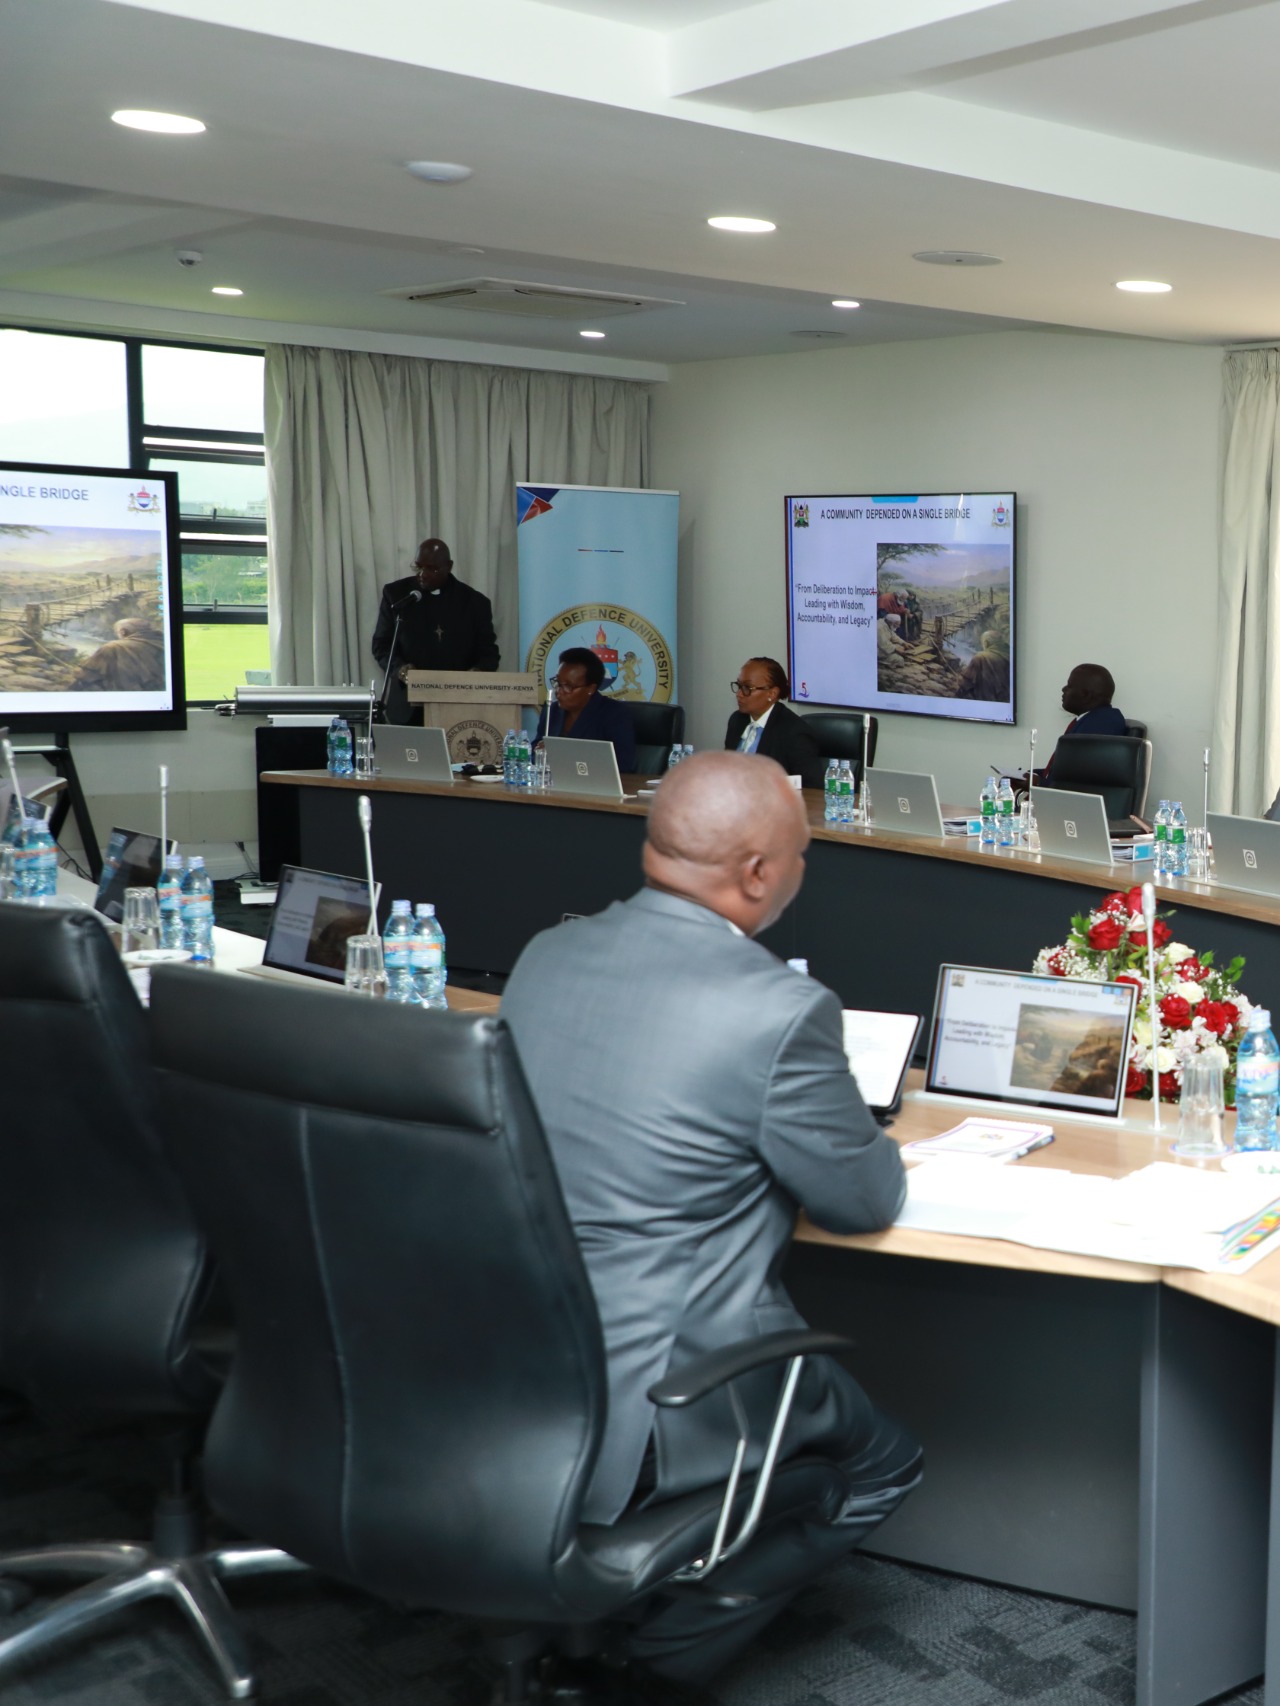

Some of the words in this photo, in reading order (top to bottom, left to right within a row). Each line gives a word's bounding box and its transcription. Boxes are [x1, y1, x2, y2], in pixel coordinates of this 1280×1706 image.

[40, 487, 89, 500] BRIDGE
[821, 510, 825, 519] A
[826, 509, 863, 519] COMMUNITY
[866, 509, 901, 519] DEPENDED
[902, 509, 912, 519] ON
[913, 509, 918, 519] A
[919, 508, 943, 519] SINGLE
[945, 508, 971, 519] BRIDGE
[813, 584, 847, 595] Deliberation
[848, 585, 854, 595] to
[804, 599, 826, 610] Leading
[828, 600, 839, 609] with
[838, 615, 848, 624] and
[562, 608, 627, 627] DEFENCE
[629, 618, 669, 690] UNIVERSITY
